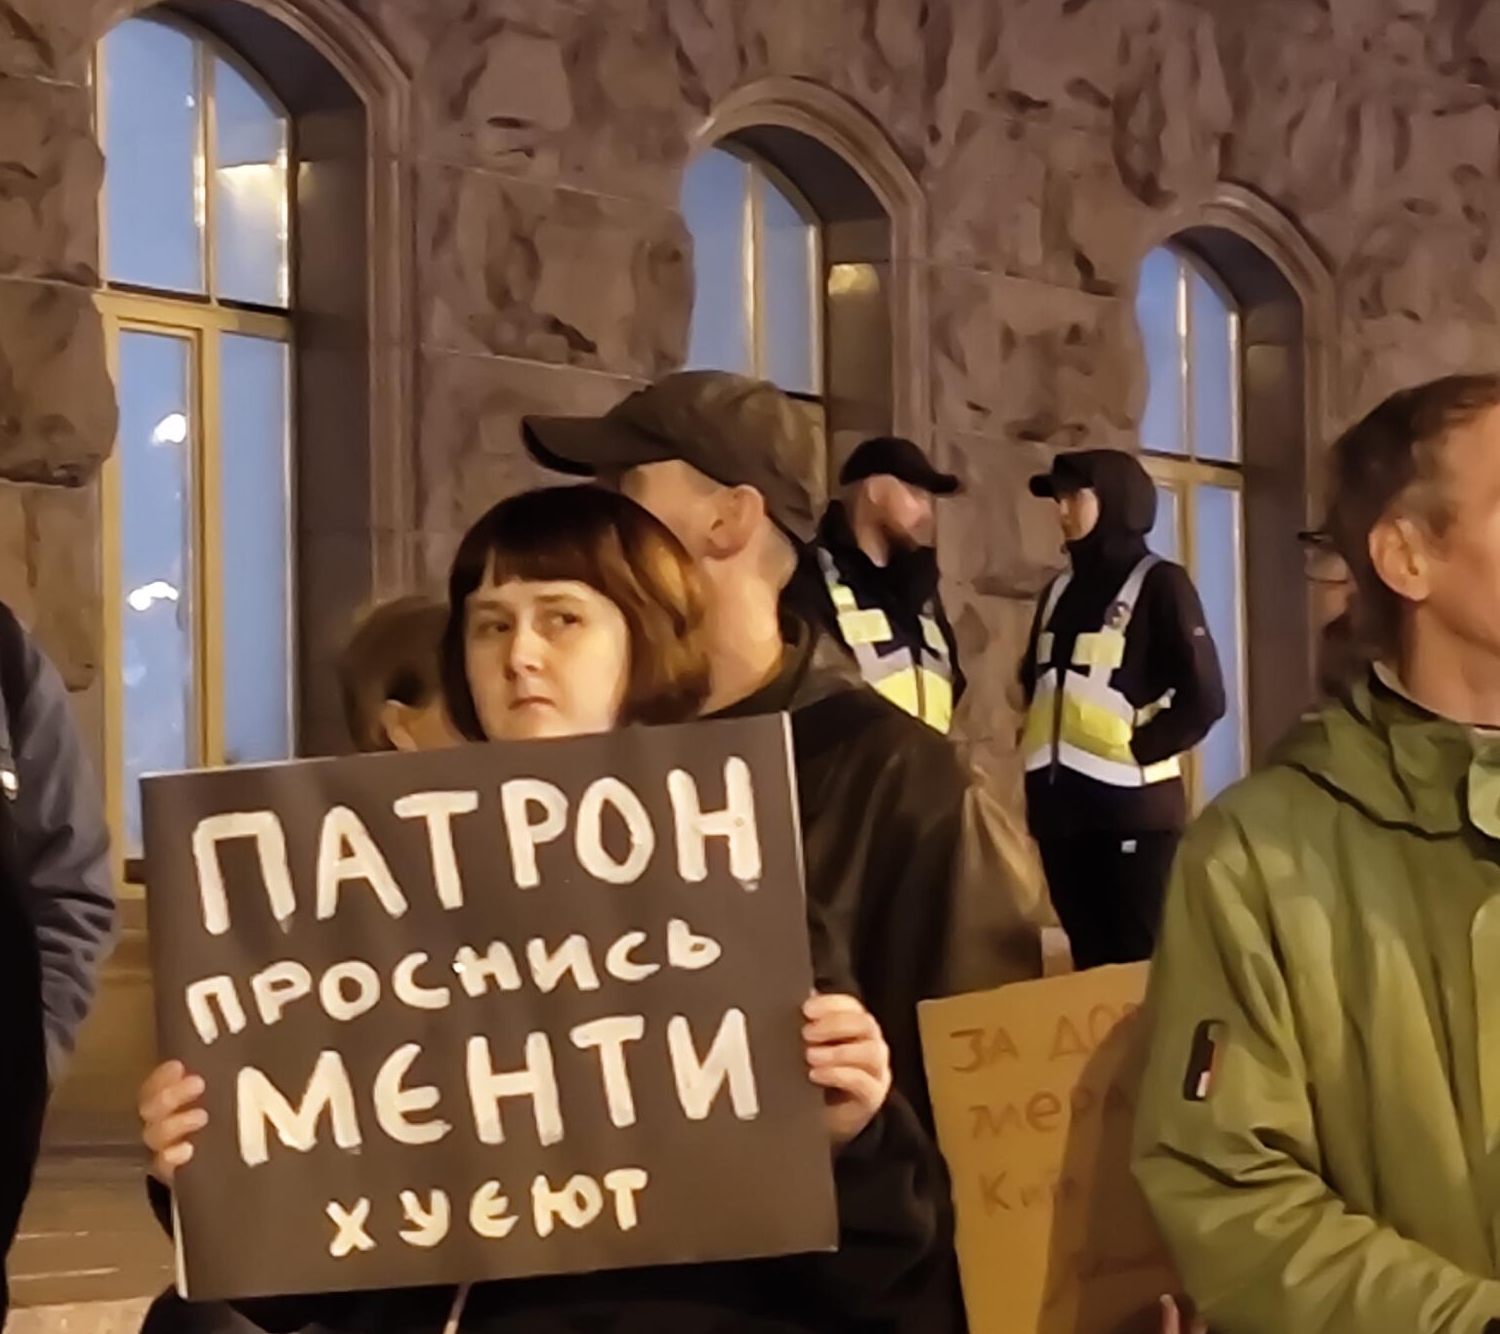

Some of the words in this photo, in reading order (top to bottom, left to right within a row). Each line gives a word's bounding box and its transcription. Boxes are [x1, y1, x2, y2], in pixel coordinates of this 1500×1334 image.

[192, 755, 762, 936] ПАТРОН
[185, 917, 723, 1045] ПРОСНИСЬ
[949, 1024, 1022, 1073] ЗА
